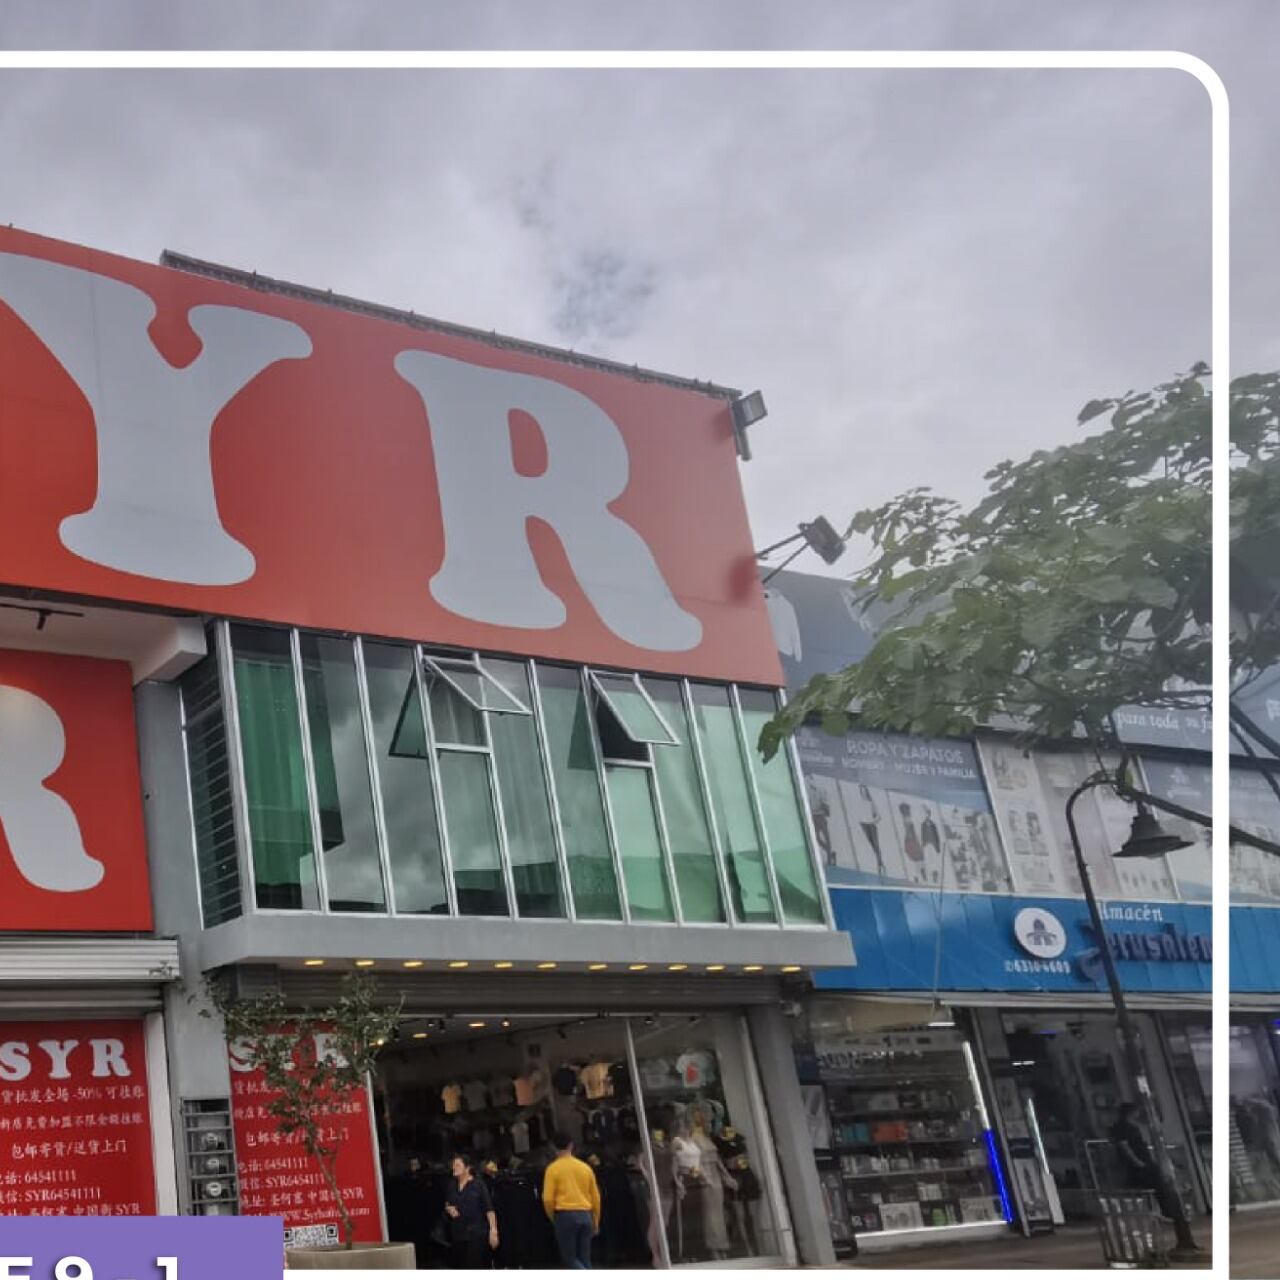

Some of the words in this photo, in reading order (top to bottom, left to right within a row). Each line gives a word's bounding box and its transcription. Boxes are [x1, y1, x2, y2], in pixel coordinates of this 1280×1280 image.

[24, 1168, 78, 1184] 64541111
[24, 1187, 102, 1203] SYR64541111
[115, 1202, 141, 1216] SYR
